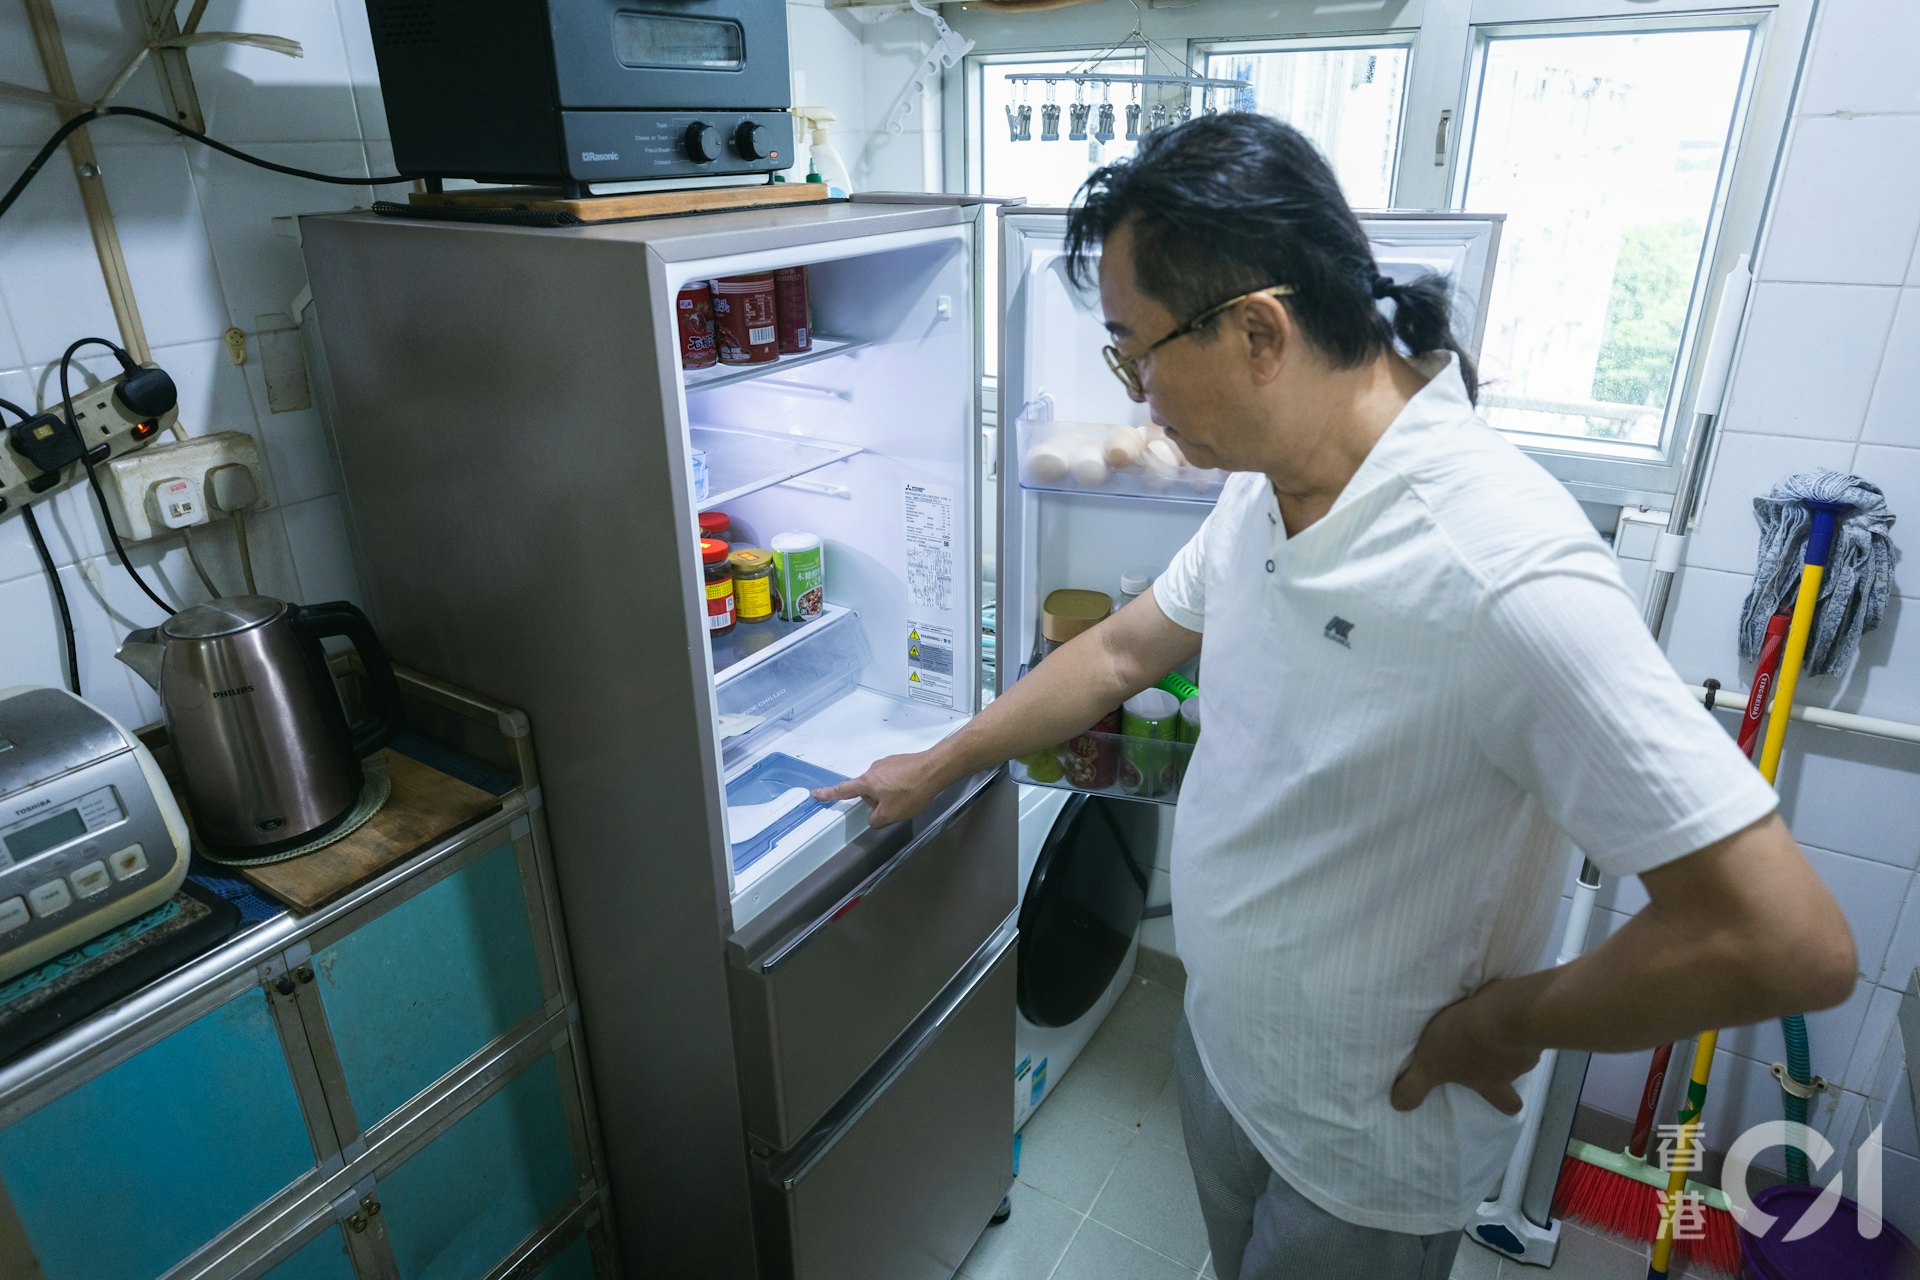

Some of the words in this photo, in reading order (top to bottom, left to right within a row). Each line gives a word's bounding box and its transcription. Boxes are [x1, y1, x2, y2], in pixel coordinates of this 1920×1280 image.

[589, 151, 619, 161] Rasonic
[212, 685, 254, 699] PHILIPS
[758, 688, 786, 707] CHILLED
[15, 798, 52, 816] TOSHIBA
